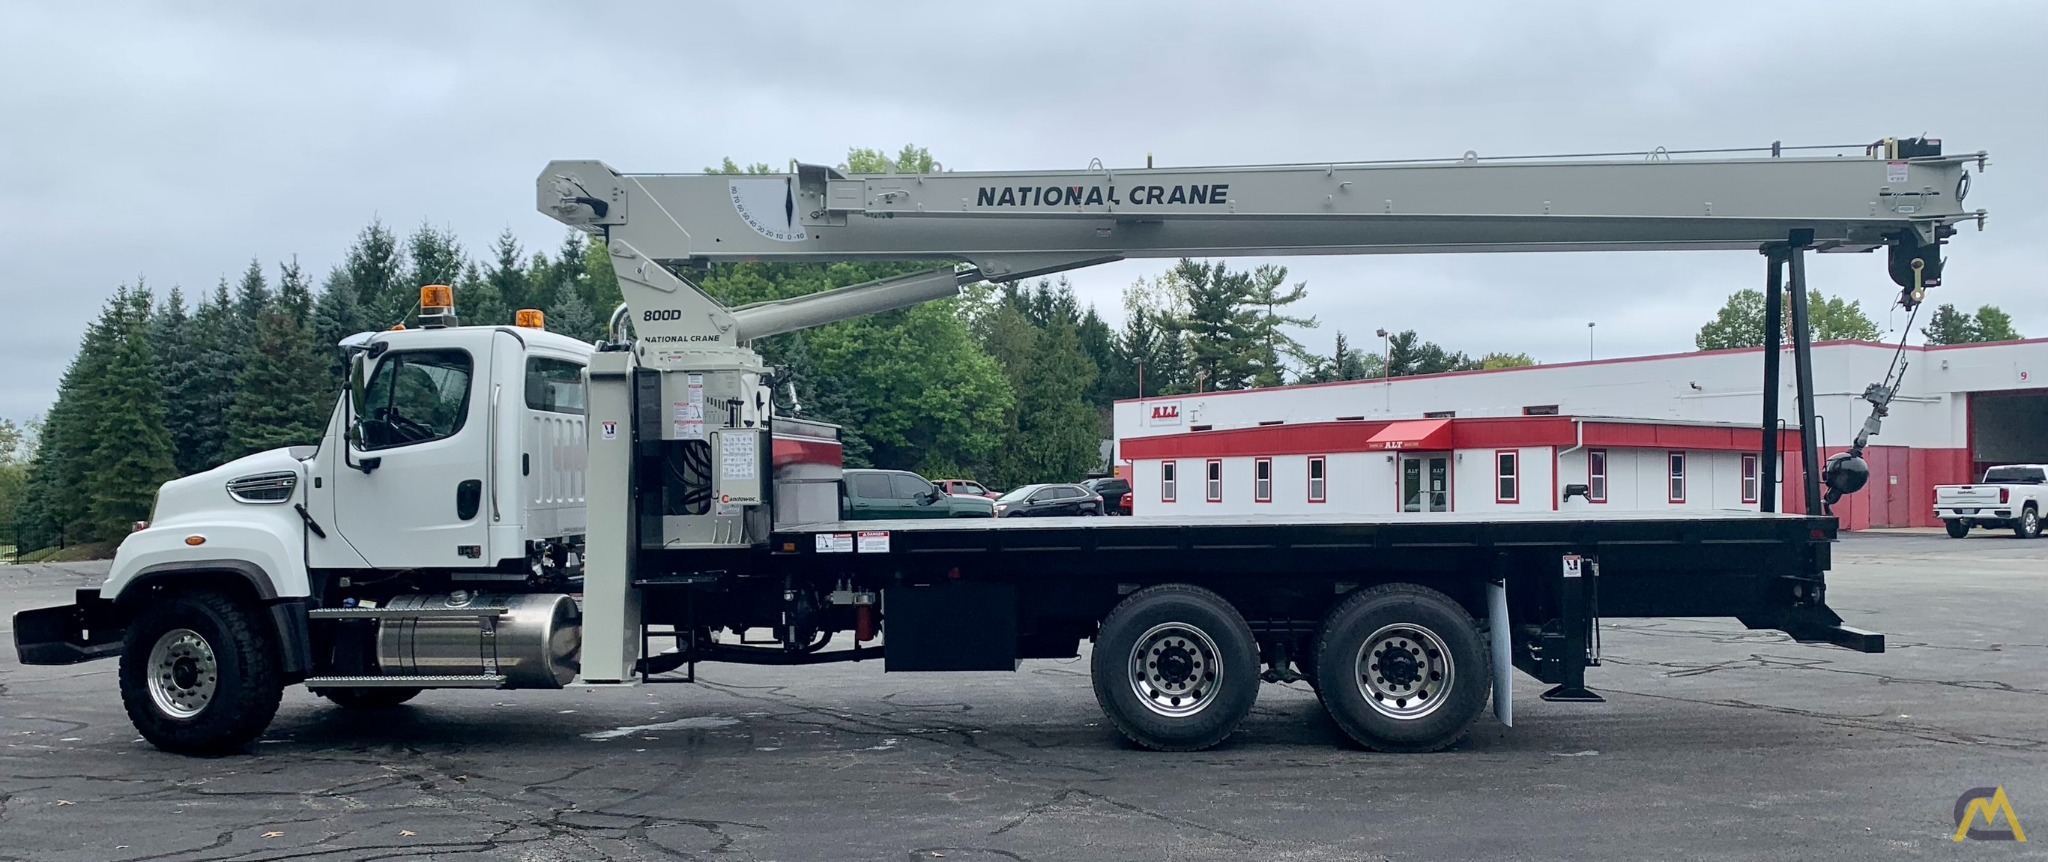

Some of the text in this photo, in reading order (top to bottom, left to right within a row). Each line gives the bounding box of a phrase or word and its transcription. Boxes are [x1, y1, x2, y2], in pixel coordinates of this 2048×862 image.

[733, 195, 740, 204] 70
[977, 184, 1229, 207] NATIONAL CRANE
[749, 220, 757, 228] 40
[757, 226, 765, 234] 30
[643, 309, 682, 322] 800D
[644, 334, 720, 343] NATIONAL CRANE
[2020, 371, 2028, 381] 9
[1151, 405, 1179, 419] ALL
[1384, 441, 1403, 449] ALT
